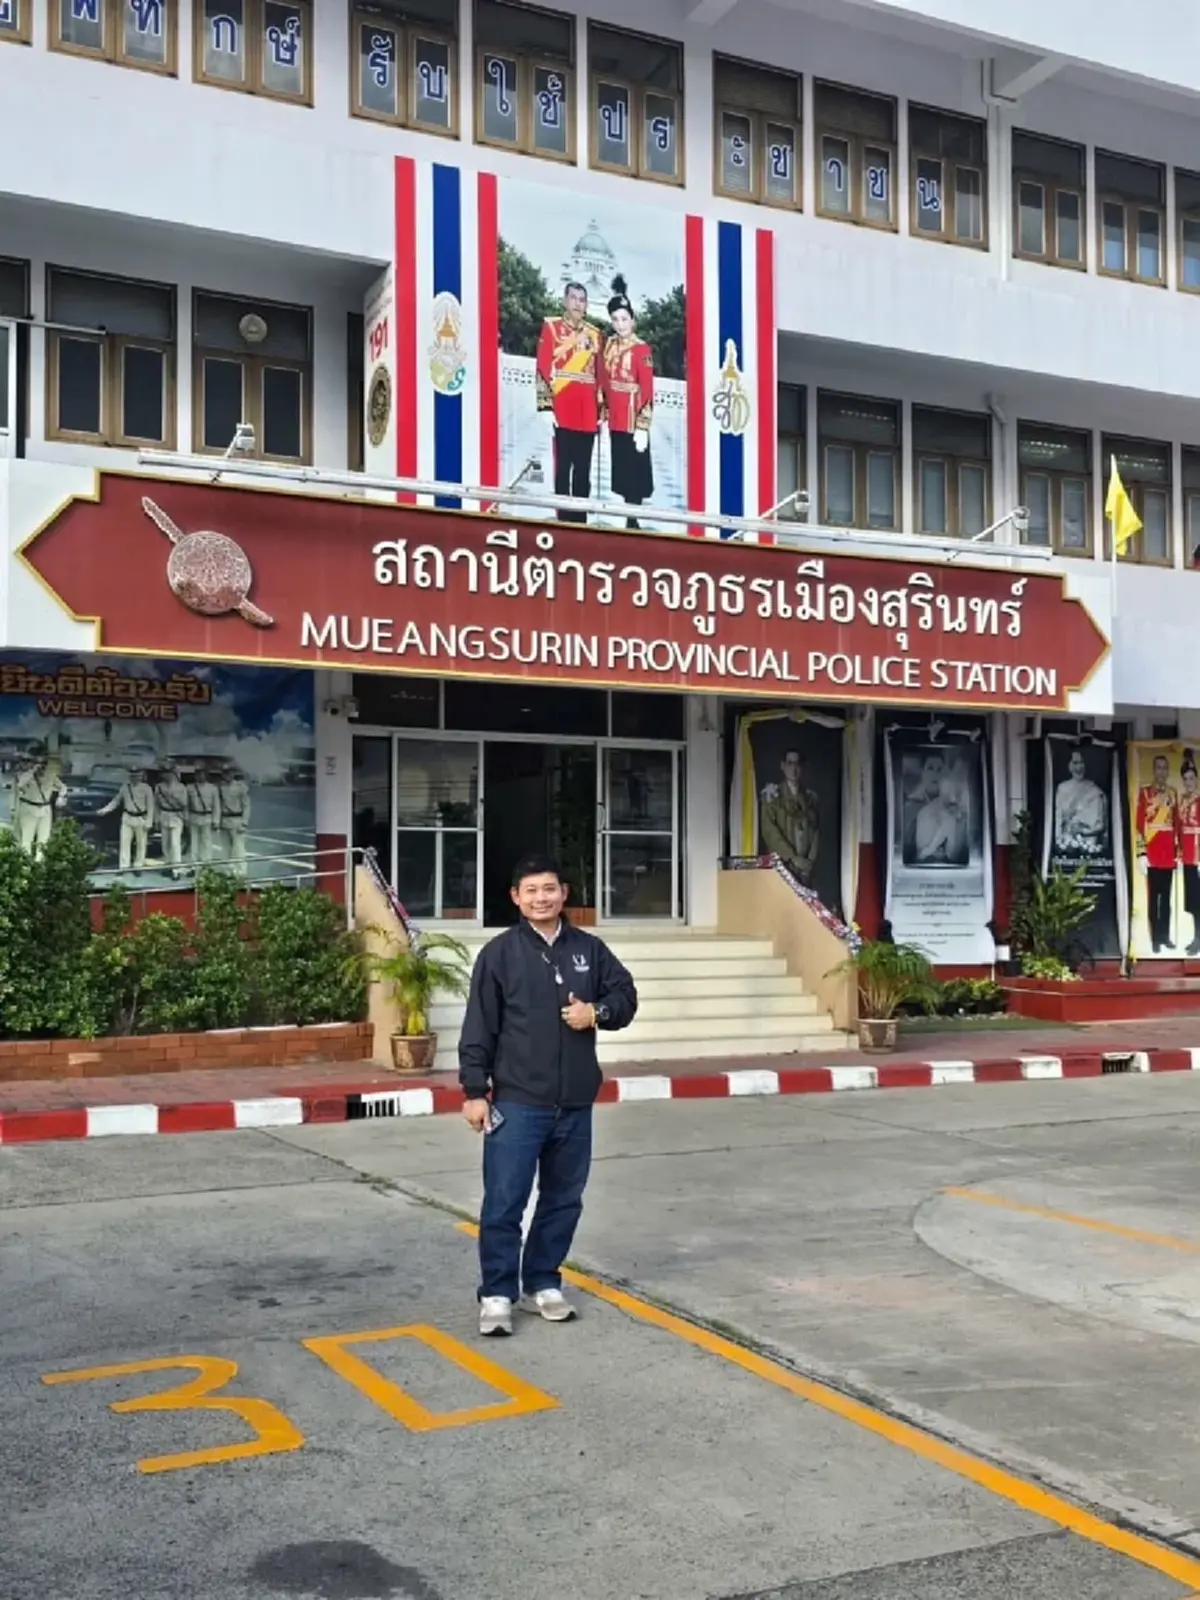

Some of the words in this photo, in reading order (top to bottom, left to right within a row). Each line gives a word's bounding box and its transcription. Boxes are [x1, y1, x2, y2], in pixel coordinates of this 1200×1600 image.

[369, 316, 389, 362] 191
[371, 528, 1028, 651] สถานีตำรวจภูธรเมืองสุรินทร์
[606, 634, 801, 682] PROVINCIAL
[807, 652, 921, 688] POLICE
[930, 660, 1058, 697] STATION
[37, 698, 177, 720] WELCOME
